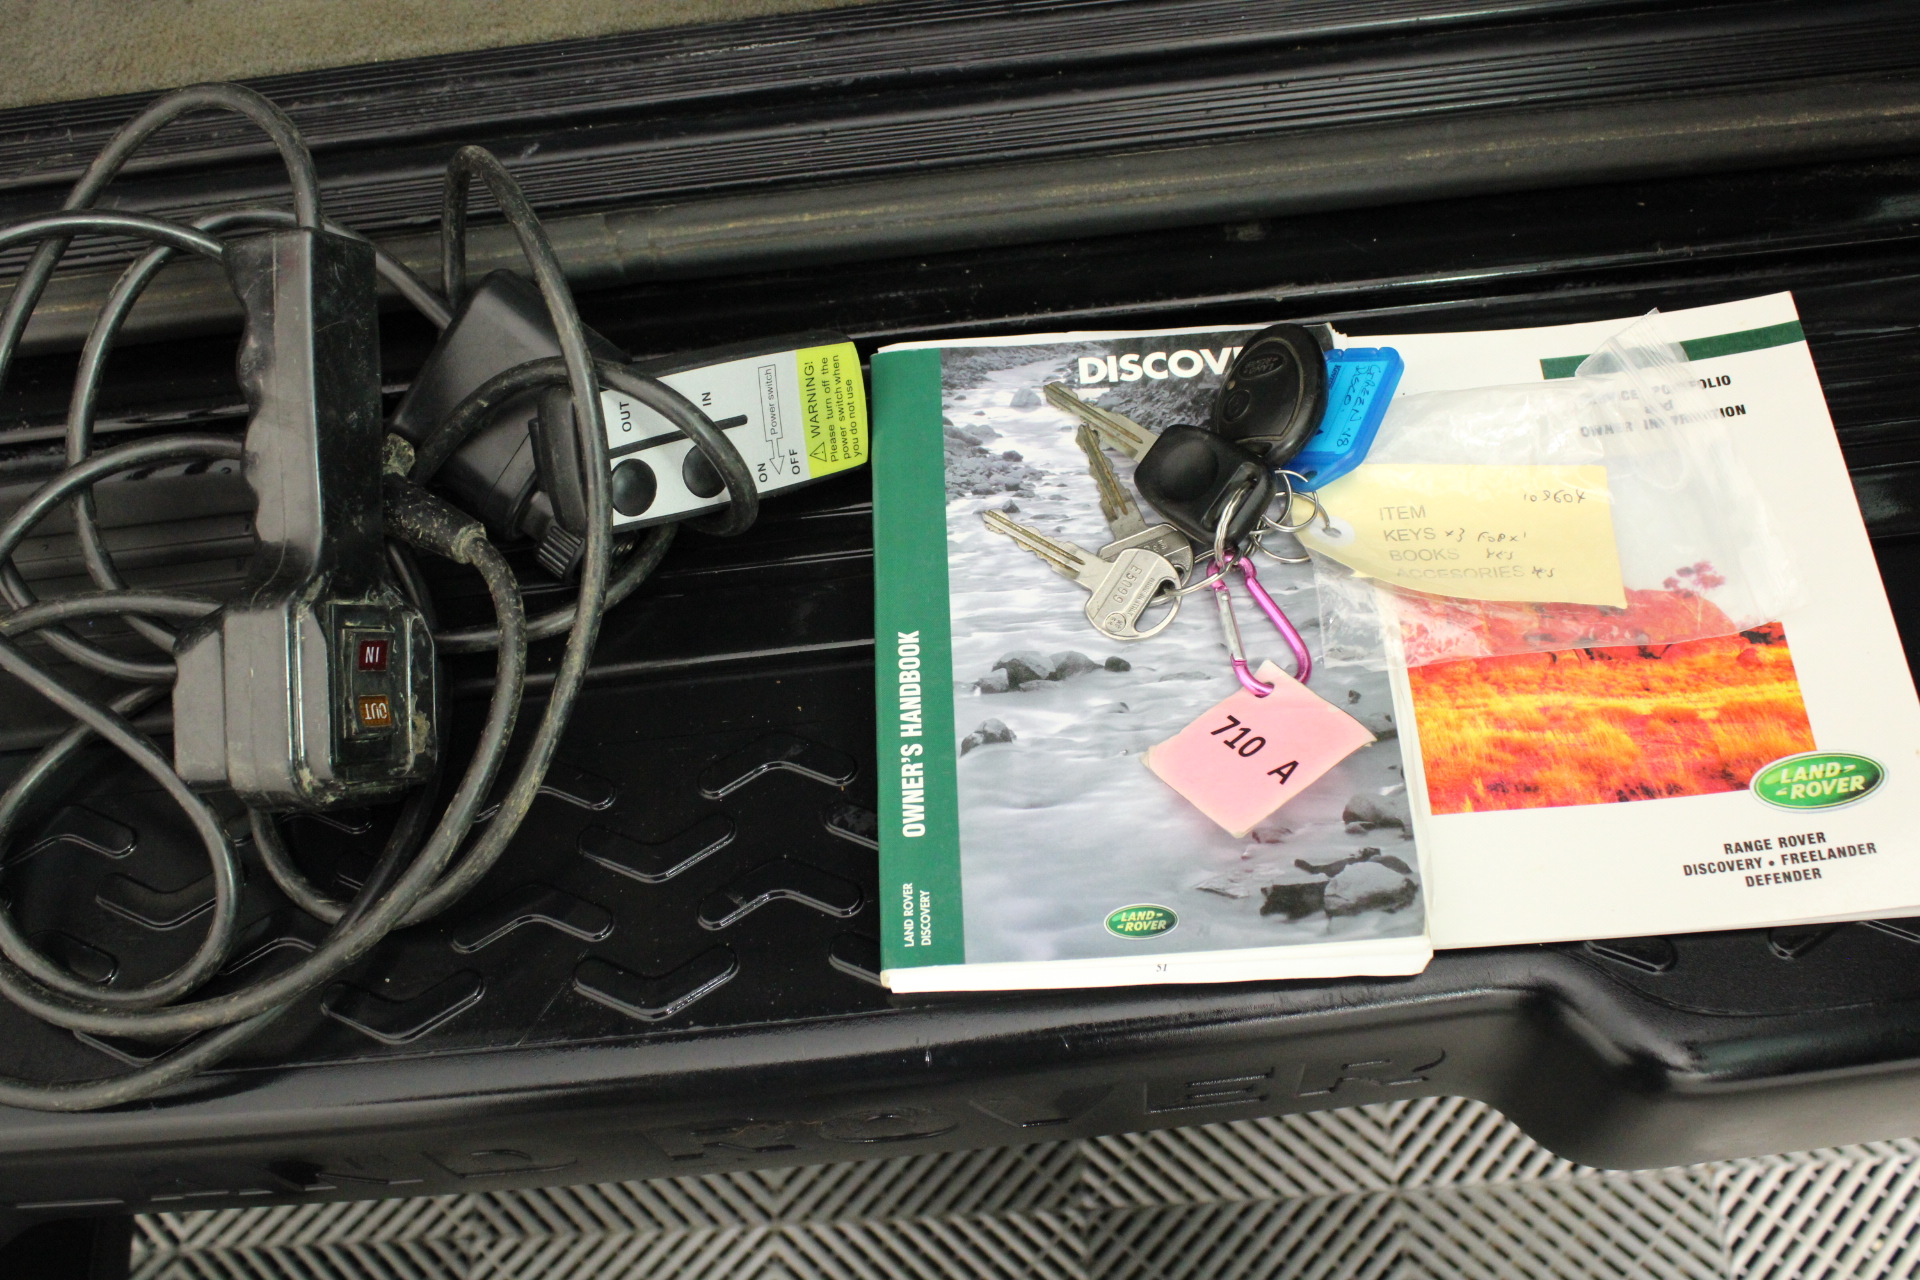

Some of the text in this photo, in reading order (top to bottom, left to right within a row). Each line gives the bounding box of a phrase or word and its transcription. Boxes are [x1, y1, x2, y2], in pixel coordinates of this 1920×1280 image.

[701, 391, 712, 407] IN
[764, 368, 779, 436] Power switch
[804, 360, 821, 439] WARNING!
[820, 357, 839, 462] Please turn off the
[832, 354, 852, 459] power switch when
[618, 401, 633, 433] OUT
[845, 379, 862, 457] you do not use
[758, 462, 768, 483] ON
[789, 448, 801, 475] OFF
[1378, 505, 1427, 521] ITEM
[1383, 527, 1437, 543] KEYS
[1389, 548, 1460, 562] BOOKS
[897, 630, 926, 838] OWNER'S HANDBOOK
[1210, 714, 1299, 785] 710 A
[1682, 842, 1877, 876] DISCOVERY FREELANDER
[1723, 831, 1827, 855] RANGE ROVER
[1745, 867, 1822, 887] DEFENDER
[902, 882, 915, 948] LAND ROVER
[920, 889, 931, 946] DISCOVERY
